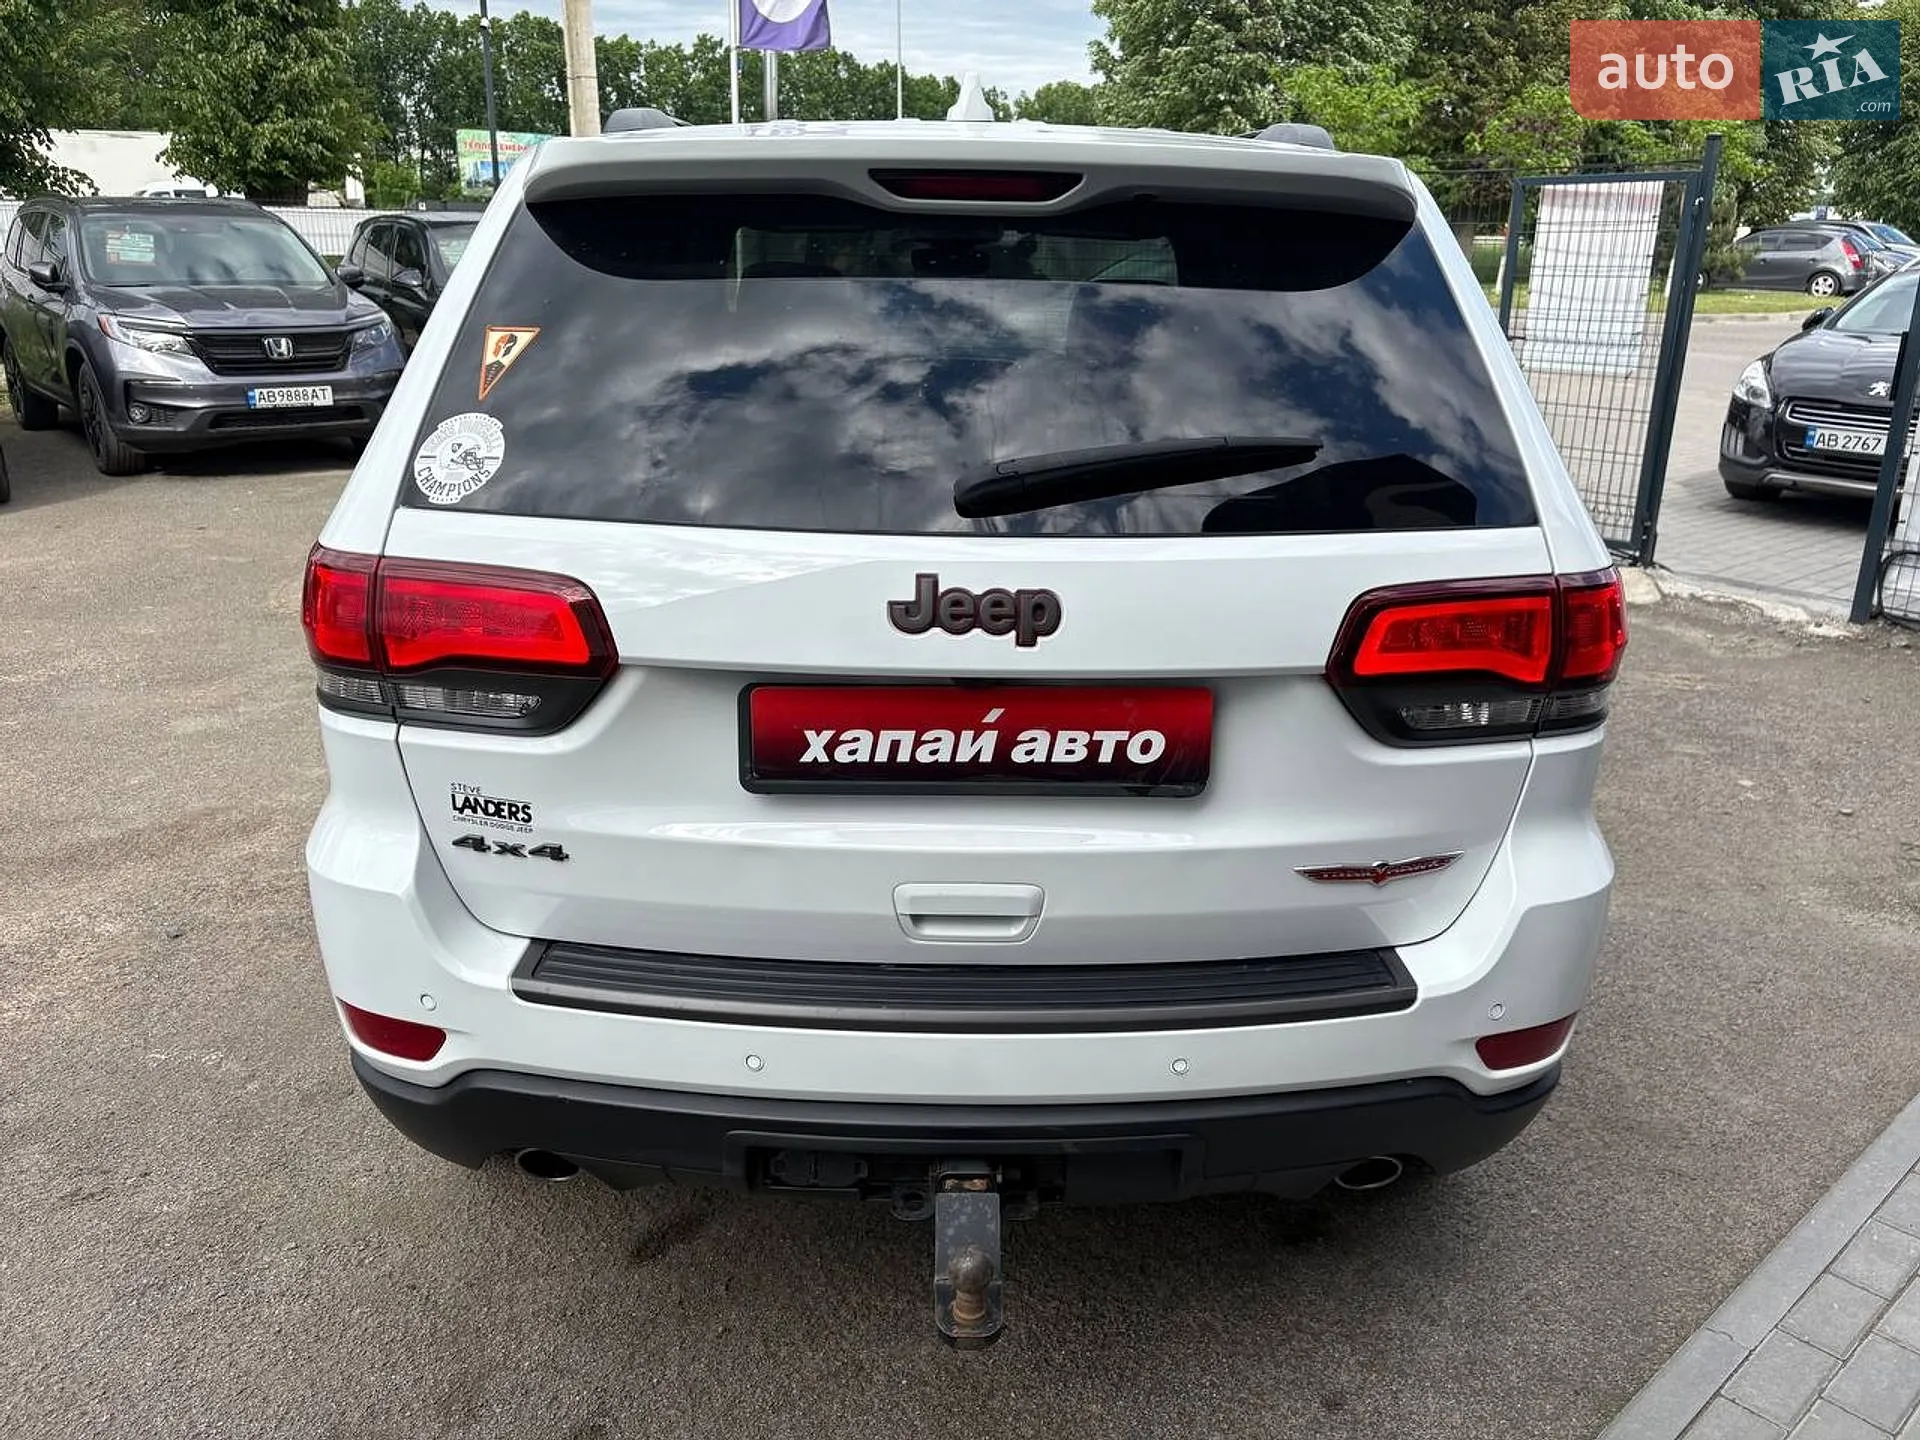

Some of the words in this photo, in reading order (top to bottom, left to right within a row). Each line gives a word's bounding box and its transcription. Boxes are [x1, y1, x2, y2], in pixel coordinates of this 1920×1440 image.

[417, 466, 491, 497] CHAMPIONS
[888, 573, 1061, 647] Jeep
[800, 708, 1005, 763] хапай
[1011, 729, 1166, 764] авто
[451, 782, 481, 794] STEVE
[451, 793, 532, 823] LANDERS
